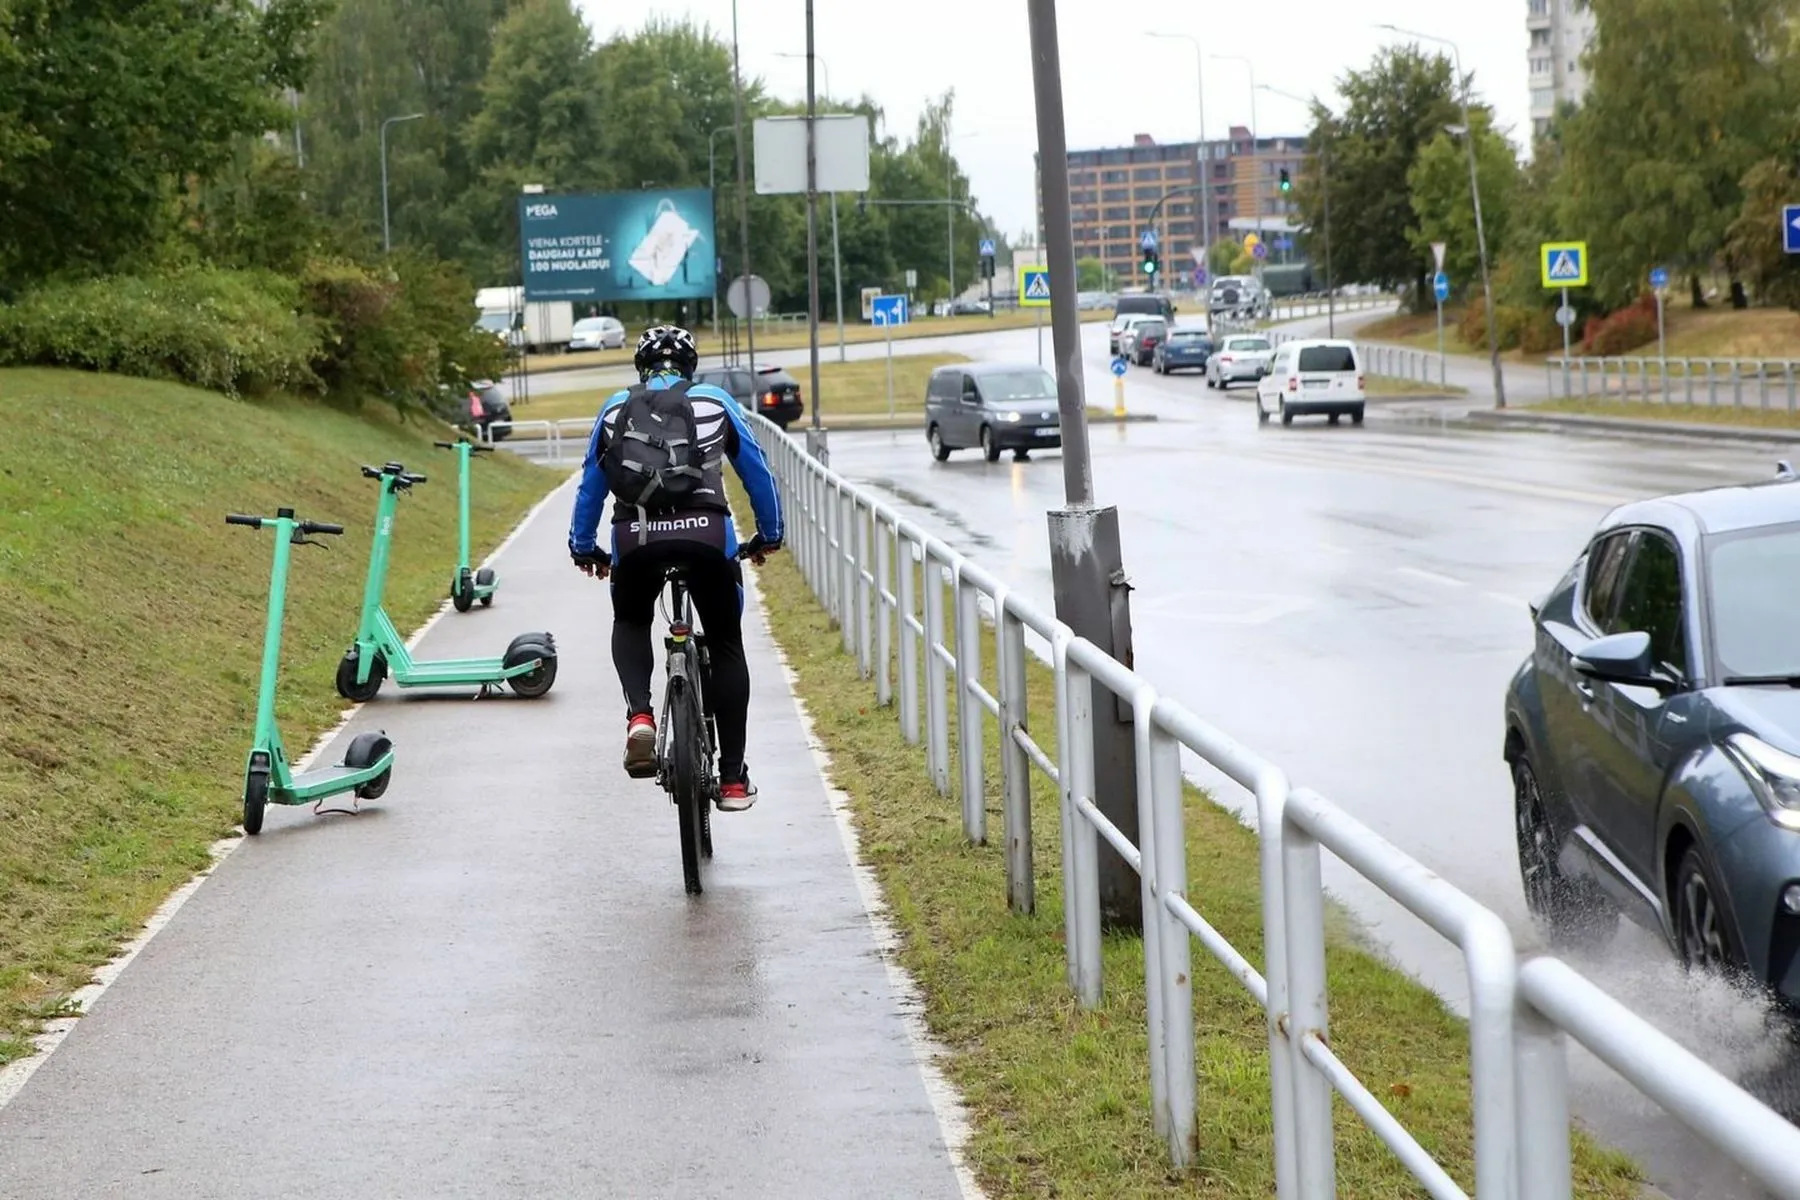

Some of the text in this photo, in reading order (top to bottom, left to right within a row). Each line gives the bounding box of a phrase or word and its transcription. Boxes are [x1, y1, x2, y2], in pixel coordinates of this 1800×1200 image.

[528, 238, 558, 248] VIENA
[528, 247, 602, 260] DAUGIAU KAIP
[530, 261, 550, 272] 100
